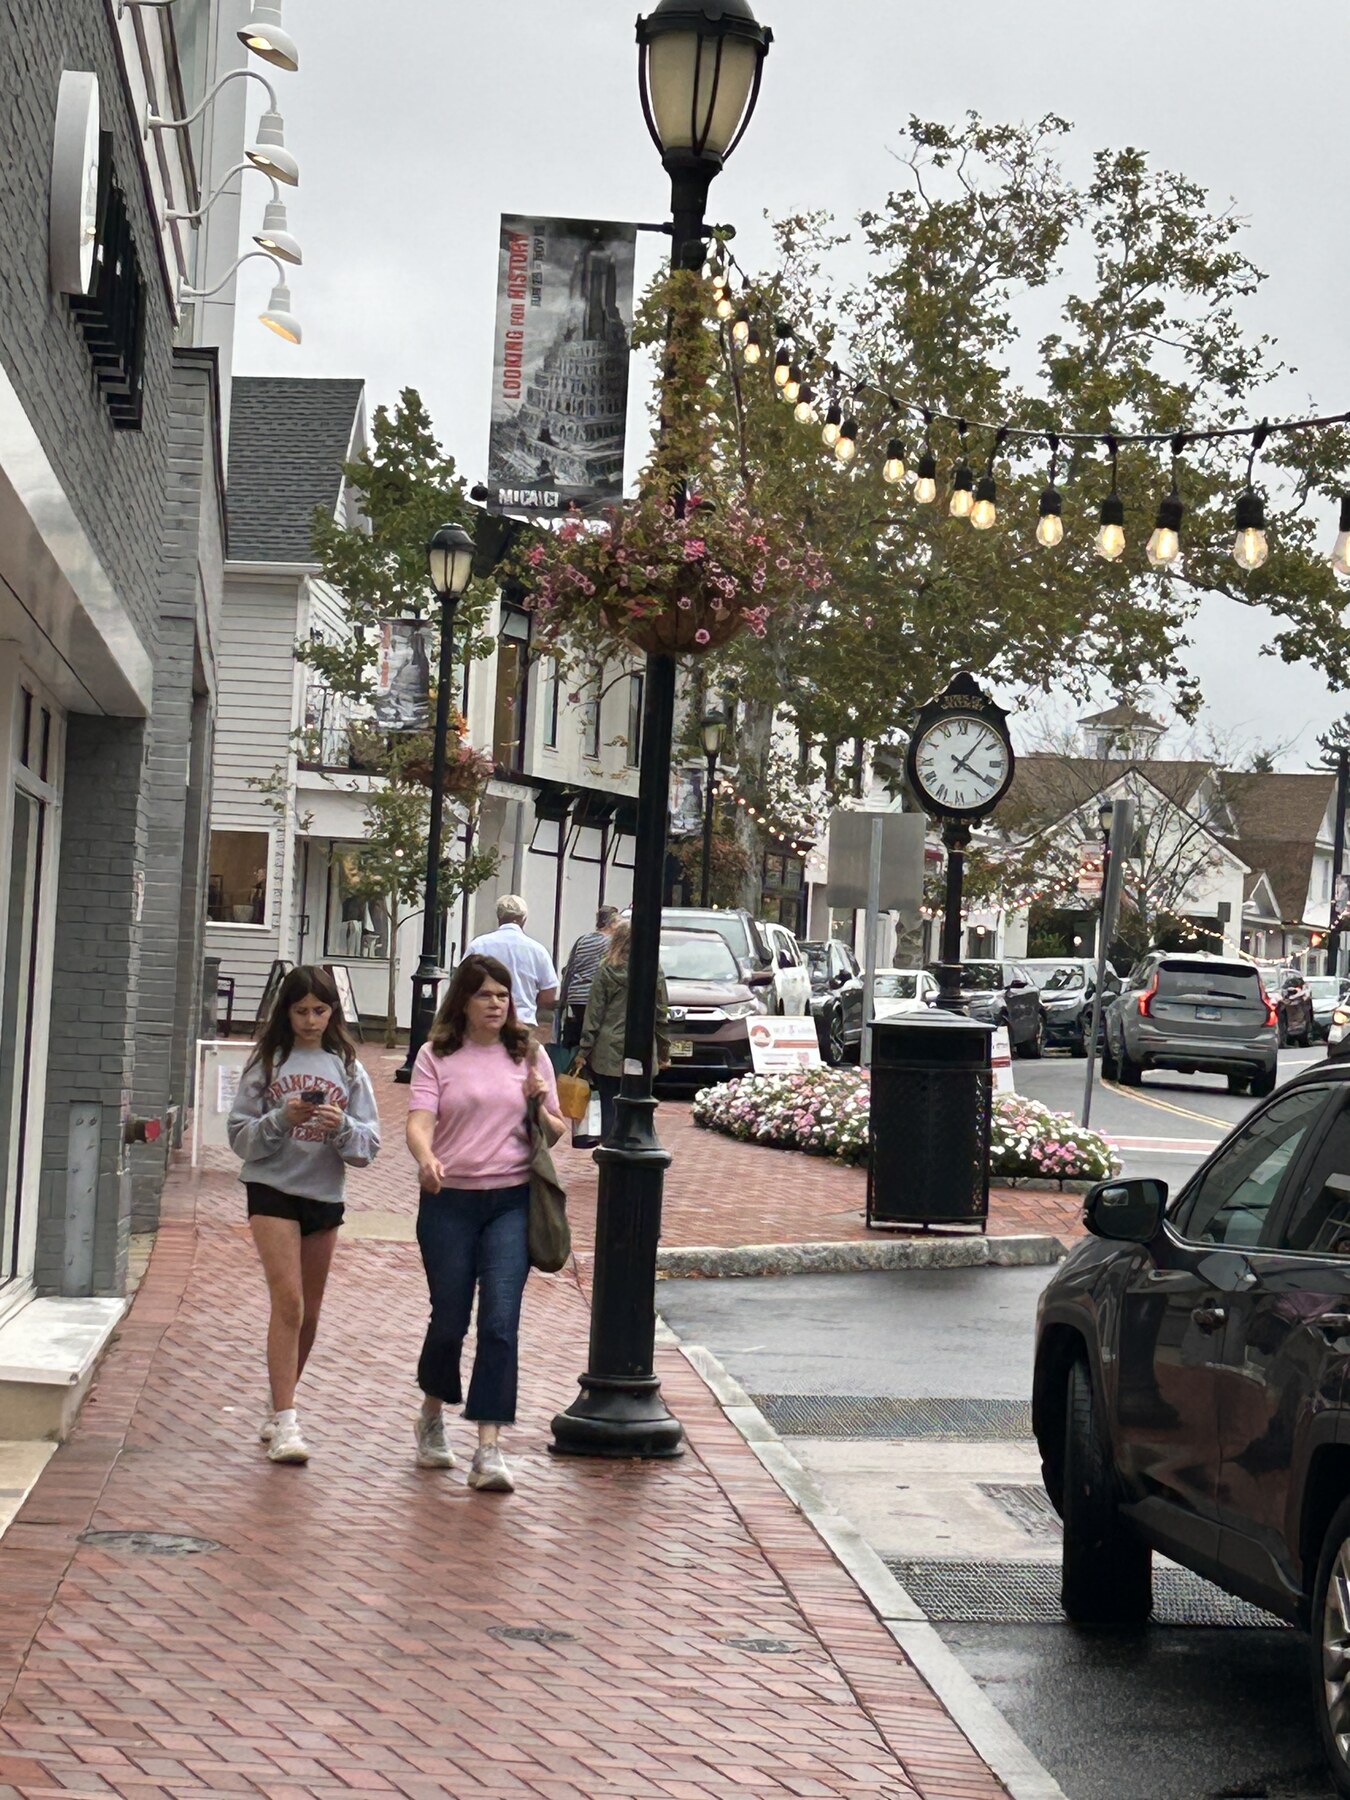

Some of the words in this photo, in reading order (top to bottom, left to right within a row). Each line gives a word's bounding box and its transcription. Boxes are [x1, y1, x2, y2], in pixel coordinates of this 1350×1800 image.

[507, 231, 530, 300] HISTORY
[510, 303, 526, 326] FOR
[503, 330, 524, 399] LOOKING
